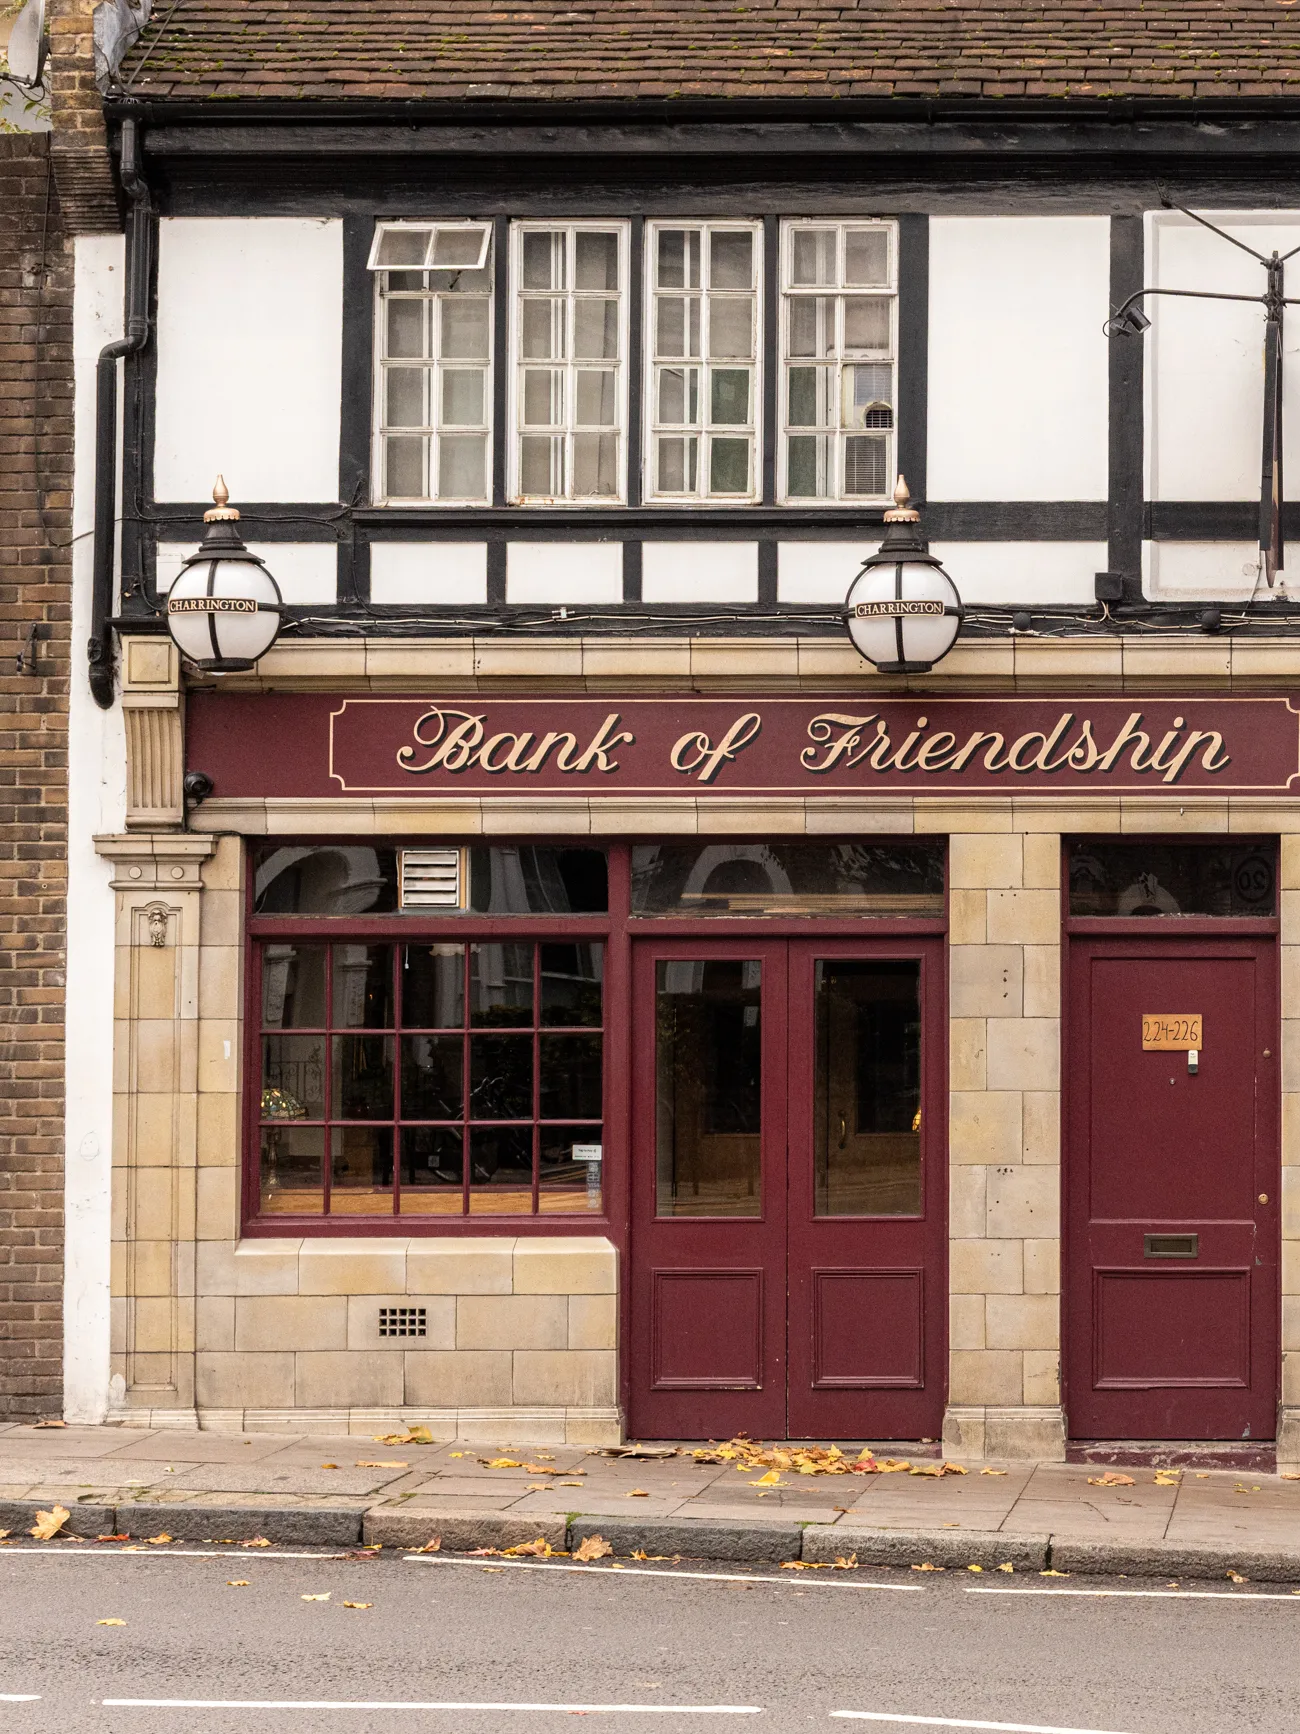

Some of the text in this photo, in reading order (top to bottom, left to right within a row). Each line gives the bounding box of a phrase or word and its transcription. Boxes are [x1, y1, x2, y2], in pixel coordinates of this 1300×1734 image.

[170, 599, 255, 611] CHARRINGTON
[857, 602, 942, 615] CHARRINGTON
[396, 705, 1231, 784] Bank of Friendship
[1143, 1020, 1199, 1042] 224-226
